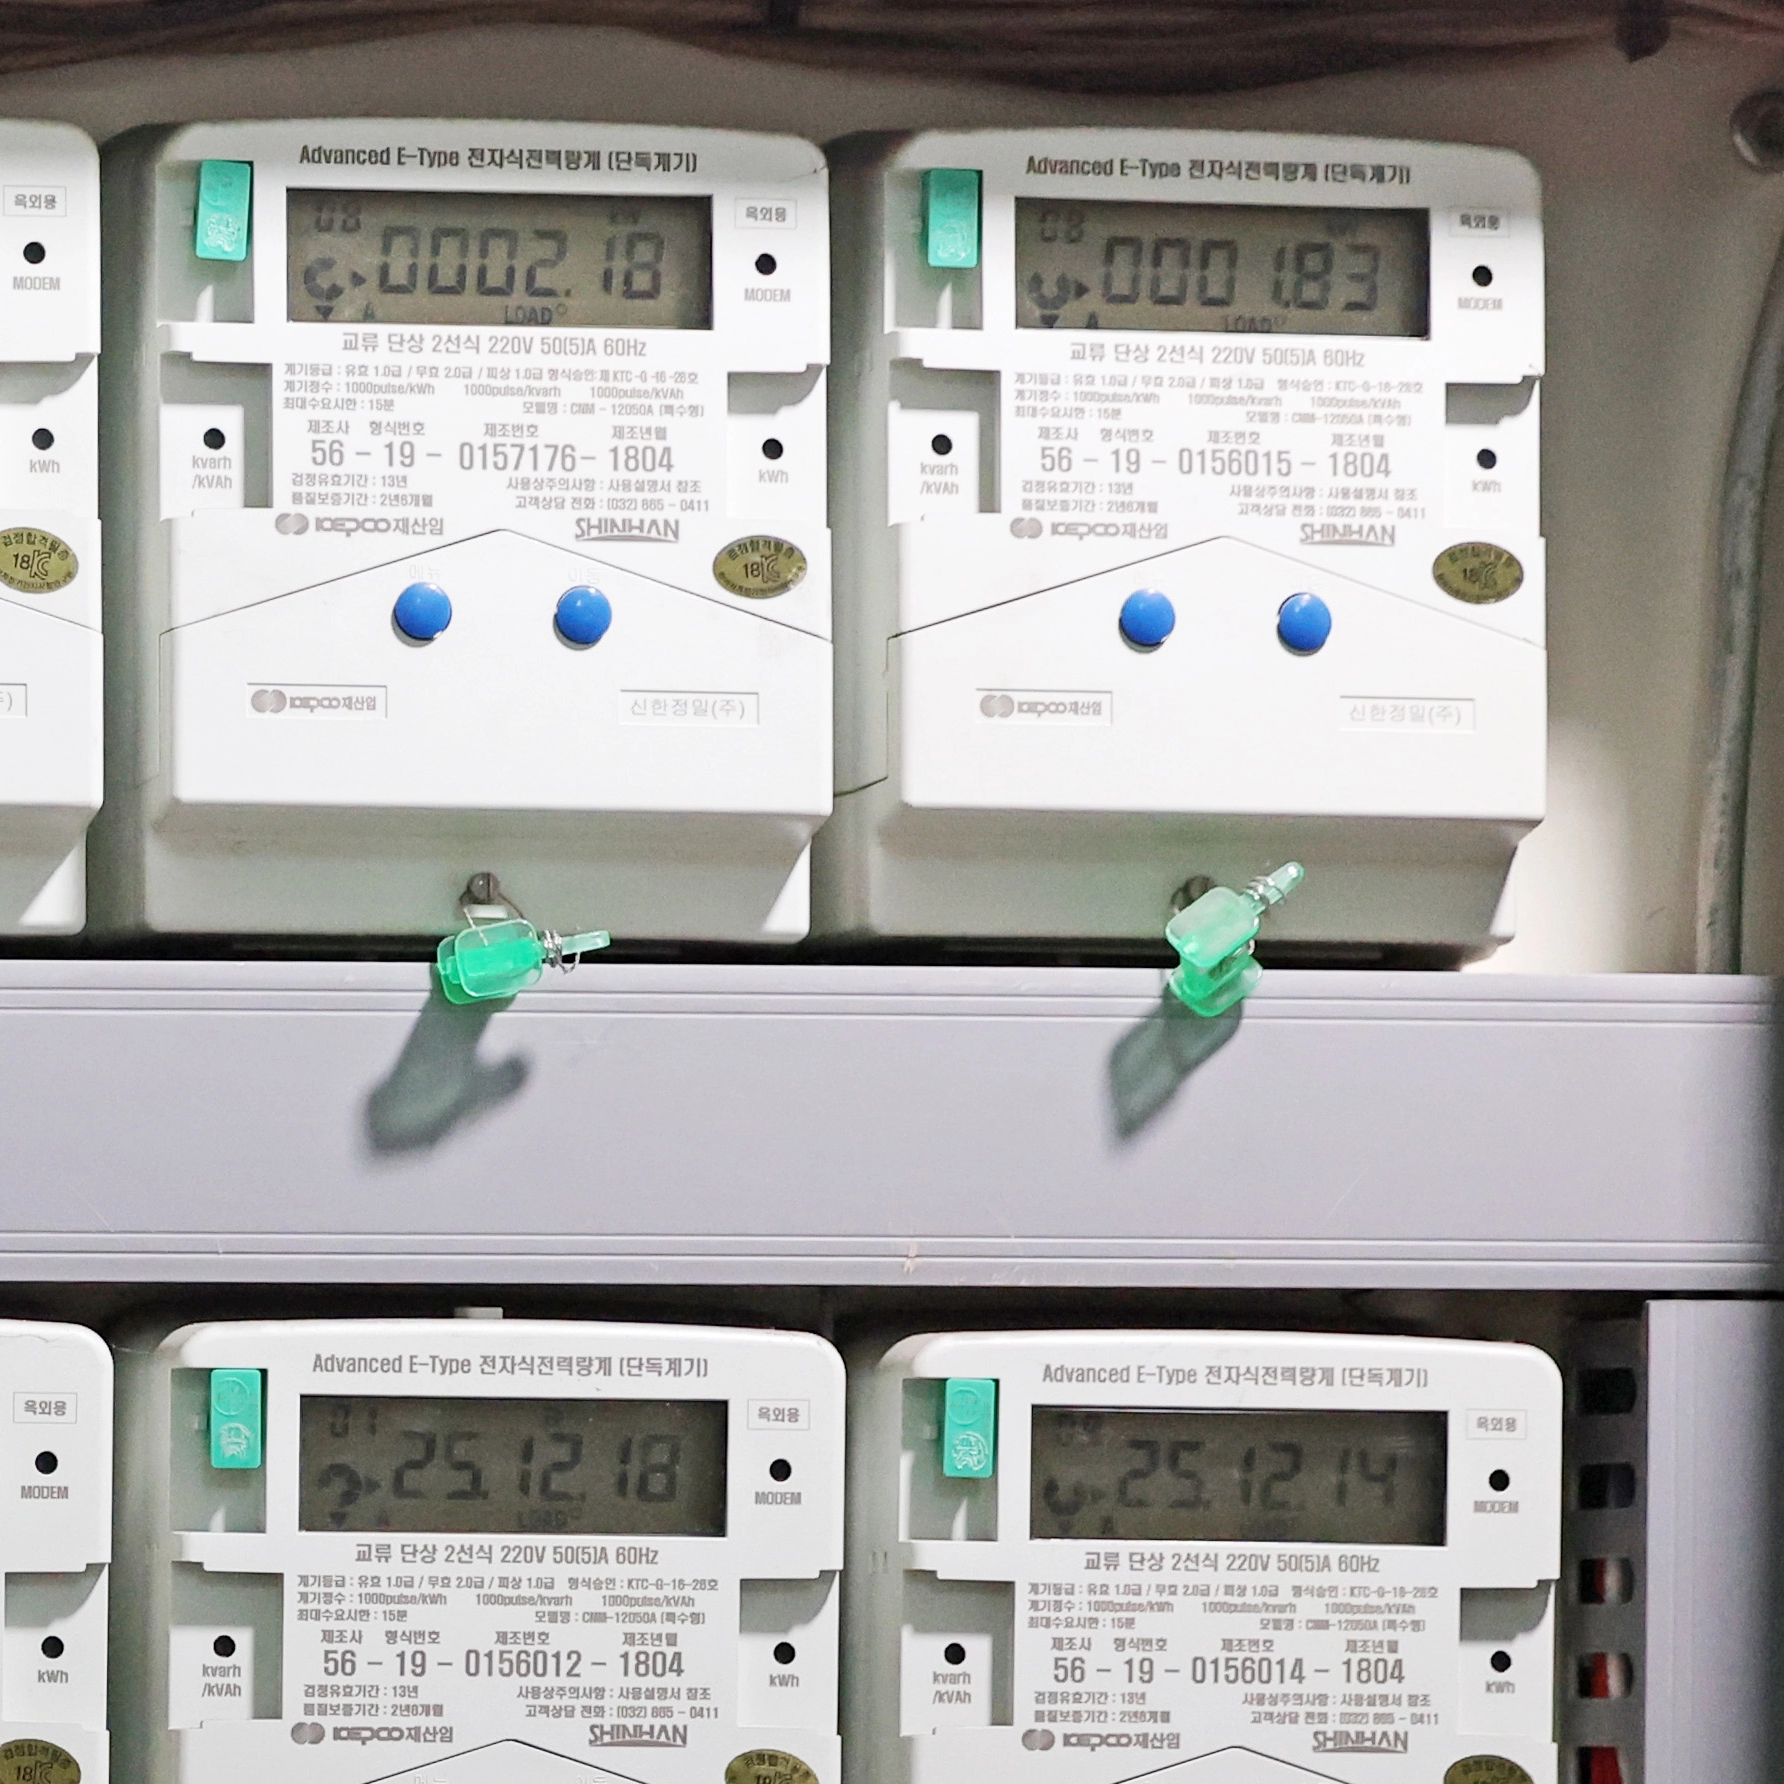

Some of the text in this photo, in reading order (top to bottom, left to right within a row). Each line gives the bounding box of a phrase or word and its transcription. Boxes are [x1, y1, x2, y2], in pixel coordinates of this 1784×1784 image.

[299, 145, 460, 168] Advanced E-Type
[1026, 155, 1181, 179] Advanced E-Type
[379, 227, 665, 299] 0002.18
[13, 276, 60, 290] MODEM
[30, 459, 60, 473] kWh
[609, 445, 674, 472] 1804
[1178, 448, 1391, 478] 0156015 1804
[13, 553, 30, 570] 18
[313, 1354, 471, 1375] Advanced E-Type
[1042, 1364, 1197, 1385] Advanced E-Type
[324, 1649, 684, 1678] 56 19 0156012 1804
[1192, 1656, 1405, 1684] 0156014 1804
